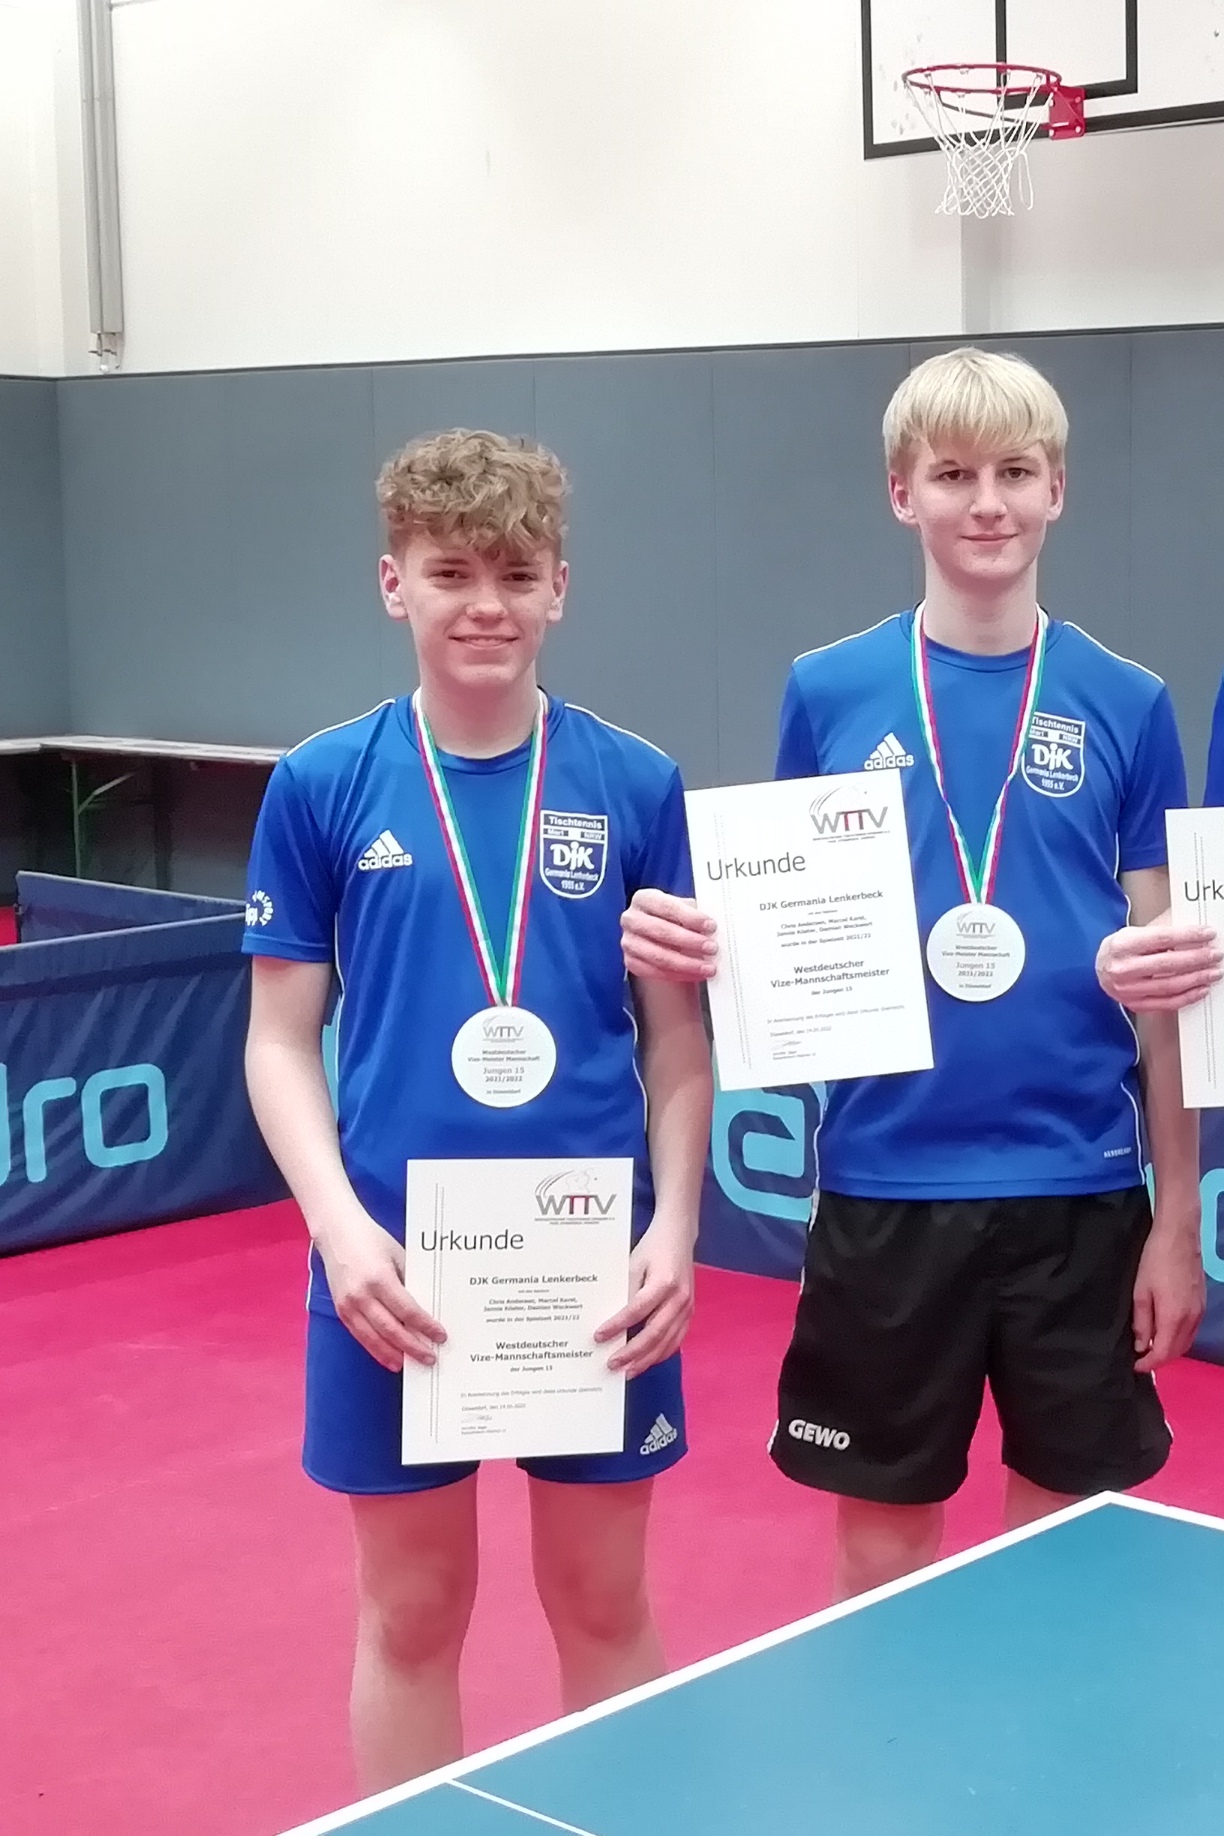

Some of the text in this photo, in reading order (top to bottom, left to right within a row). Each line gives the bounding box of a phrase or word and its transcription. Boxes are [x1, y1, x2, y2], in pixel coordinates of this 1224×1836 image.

[864, 754, 915, 770] adidas
[548, 816, 602, 829] Tischtennis
[810, 806, 888, 834] WTTV
[358, 853, 413, 871] adidas
[706, 852, 806, 881] Urkunde
[759, 889, 883, 911] DJK Germania Lenkerbeck
[957, 922, 995, 933] WTTV
[793, 958, 865, 974] Westdeutscher
[770, 966, 890, 989] Vize-Mannschaftsmeister
[483, 1026, 524, 1037] WTTV
[0, 1063, 168, 1187] ro
[535, 1194, 617, 1215] WTTV
[420, 1229, 524, 1251] Urkunde
[491, 1275, 538, 1284] Germania
[542, 1273, 597, 1282] Lenkerbeck
[495, 1339, 569, 1350] Westdeutscher
[469, 1349, 593, 1362] Vize-Mannschaftsmeister
[788, 1419, 850, 1450] GEWO
